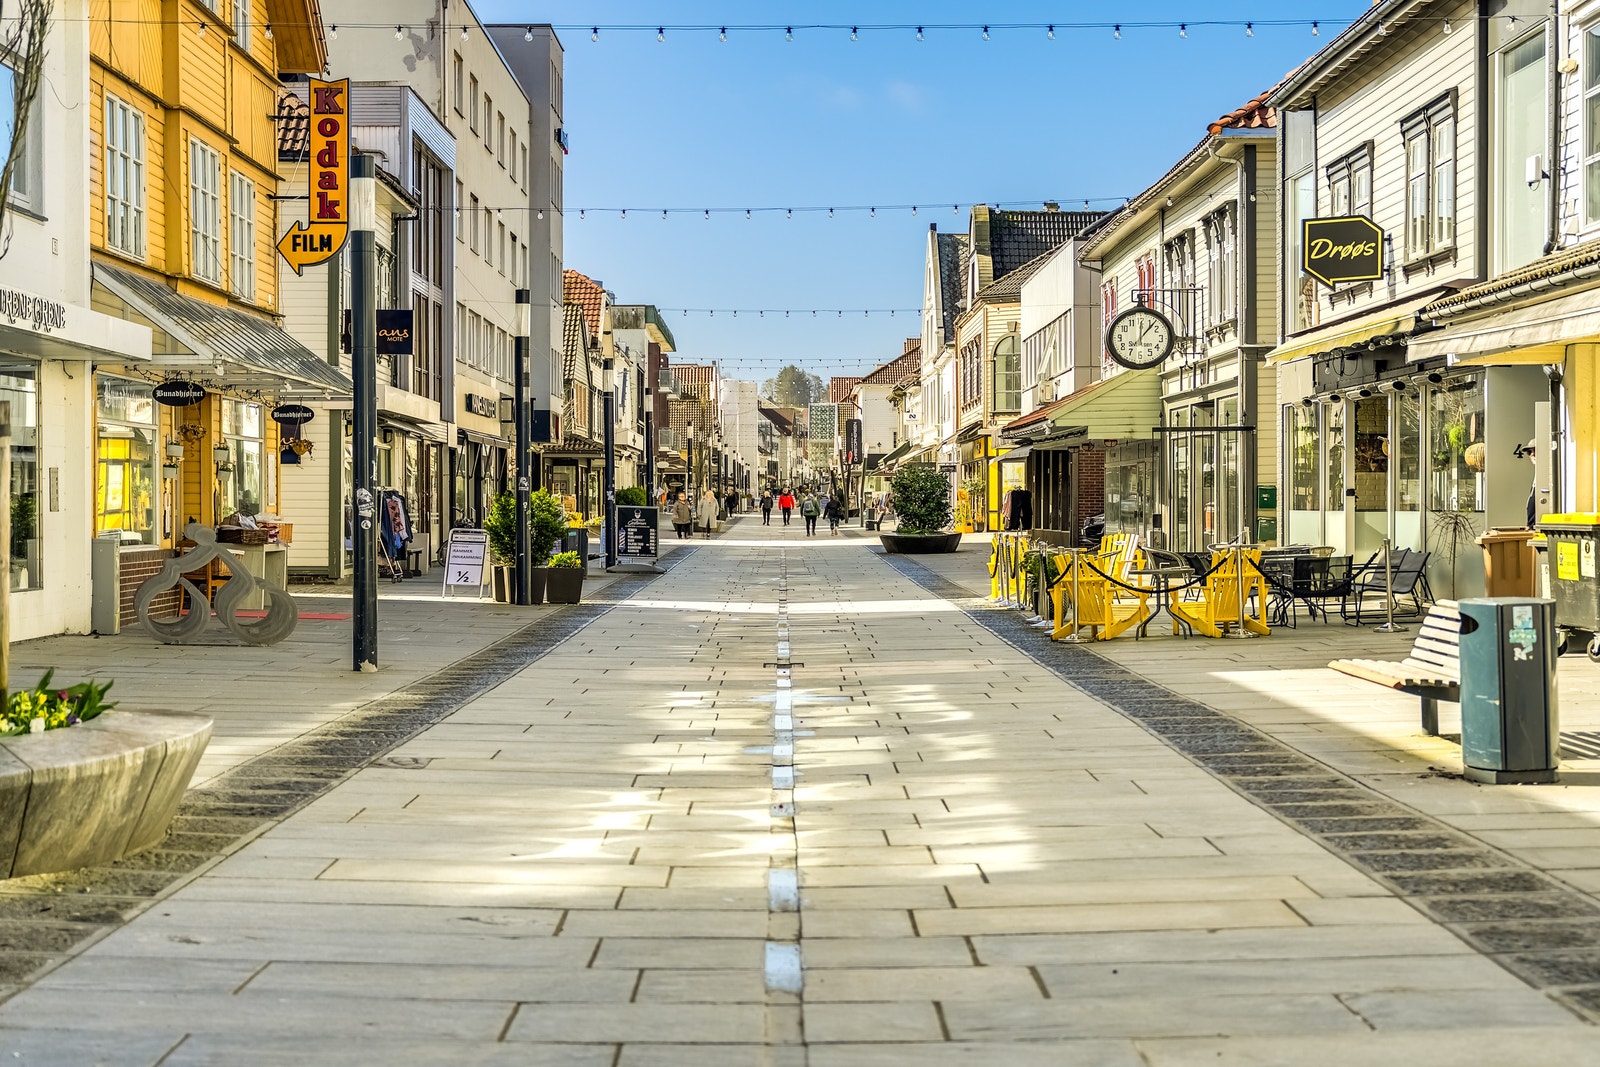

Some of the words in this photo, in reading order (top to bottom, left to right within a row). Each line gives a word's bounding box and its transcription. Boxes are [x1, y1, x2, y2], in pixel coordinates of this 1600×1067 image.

[314, 88, 343, 219] Kodak
[292, 234, 332, 252] FILM
[1311, 238, 1376, 260] Drøøs
[32, 297, 66, 333] GRENE
[1129, 319, 1135, 327] 11
[378, 328, 409, 338] ans
[1154, 325, 1160, 333] 2
[1117, 334, 1122, 342] 9
[1159, 335, 1164, 343] 3
[1154, 343, 1160, 351] 4
[1129, 348, 1134, 356] 7
[1137, 351, 1143, 359] 6
[1147, 349, 1153, 357] 5
[1513, 443, 1524, 458] 4
